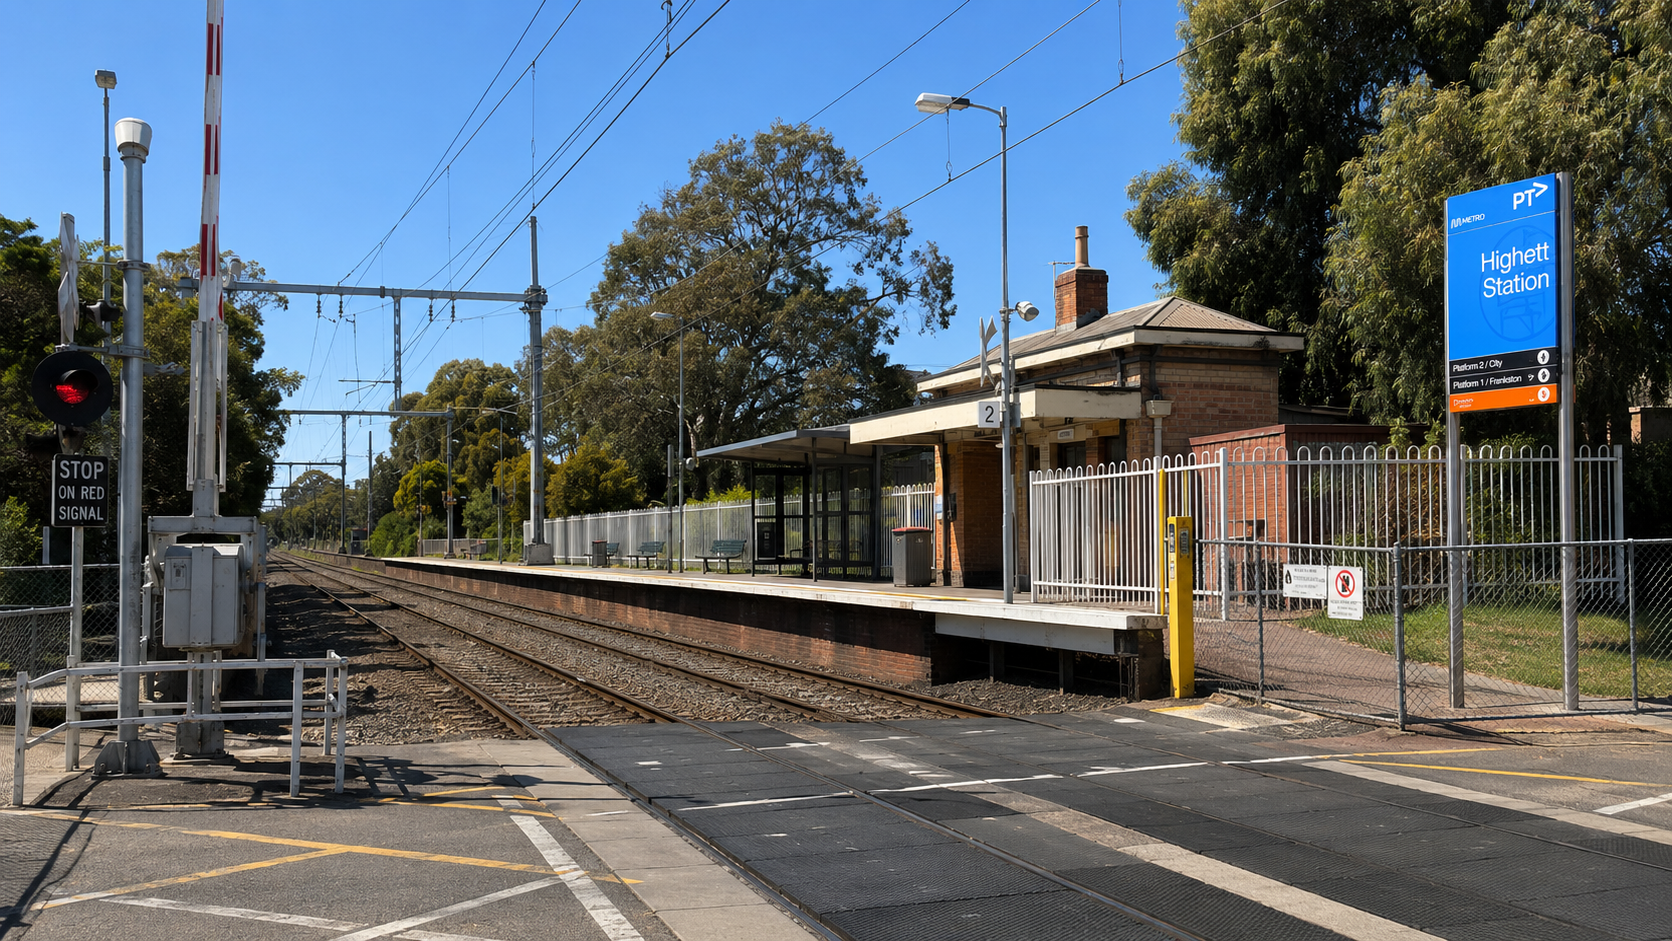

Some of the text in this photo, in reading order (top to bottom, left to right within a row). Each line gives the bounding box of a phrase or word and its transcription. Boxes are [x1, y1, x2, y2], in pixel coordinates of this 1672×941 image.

[1481, 241, 1550, 274] Highett
[1483, 271, 1549, 298] Station
[1453, 362, 1479, 372] Platform
[1489, 359, 1503, 368] City
[1453, 379, 1479, 389] Platform
[985, 405, 994, 423] 2
[59, 460, 105, 480] STOP
[58, 485, 105, 500] ON RED
[58, 506, 104, 520] SIGNAL
